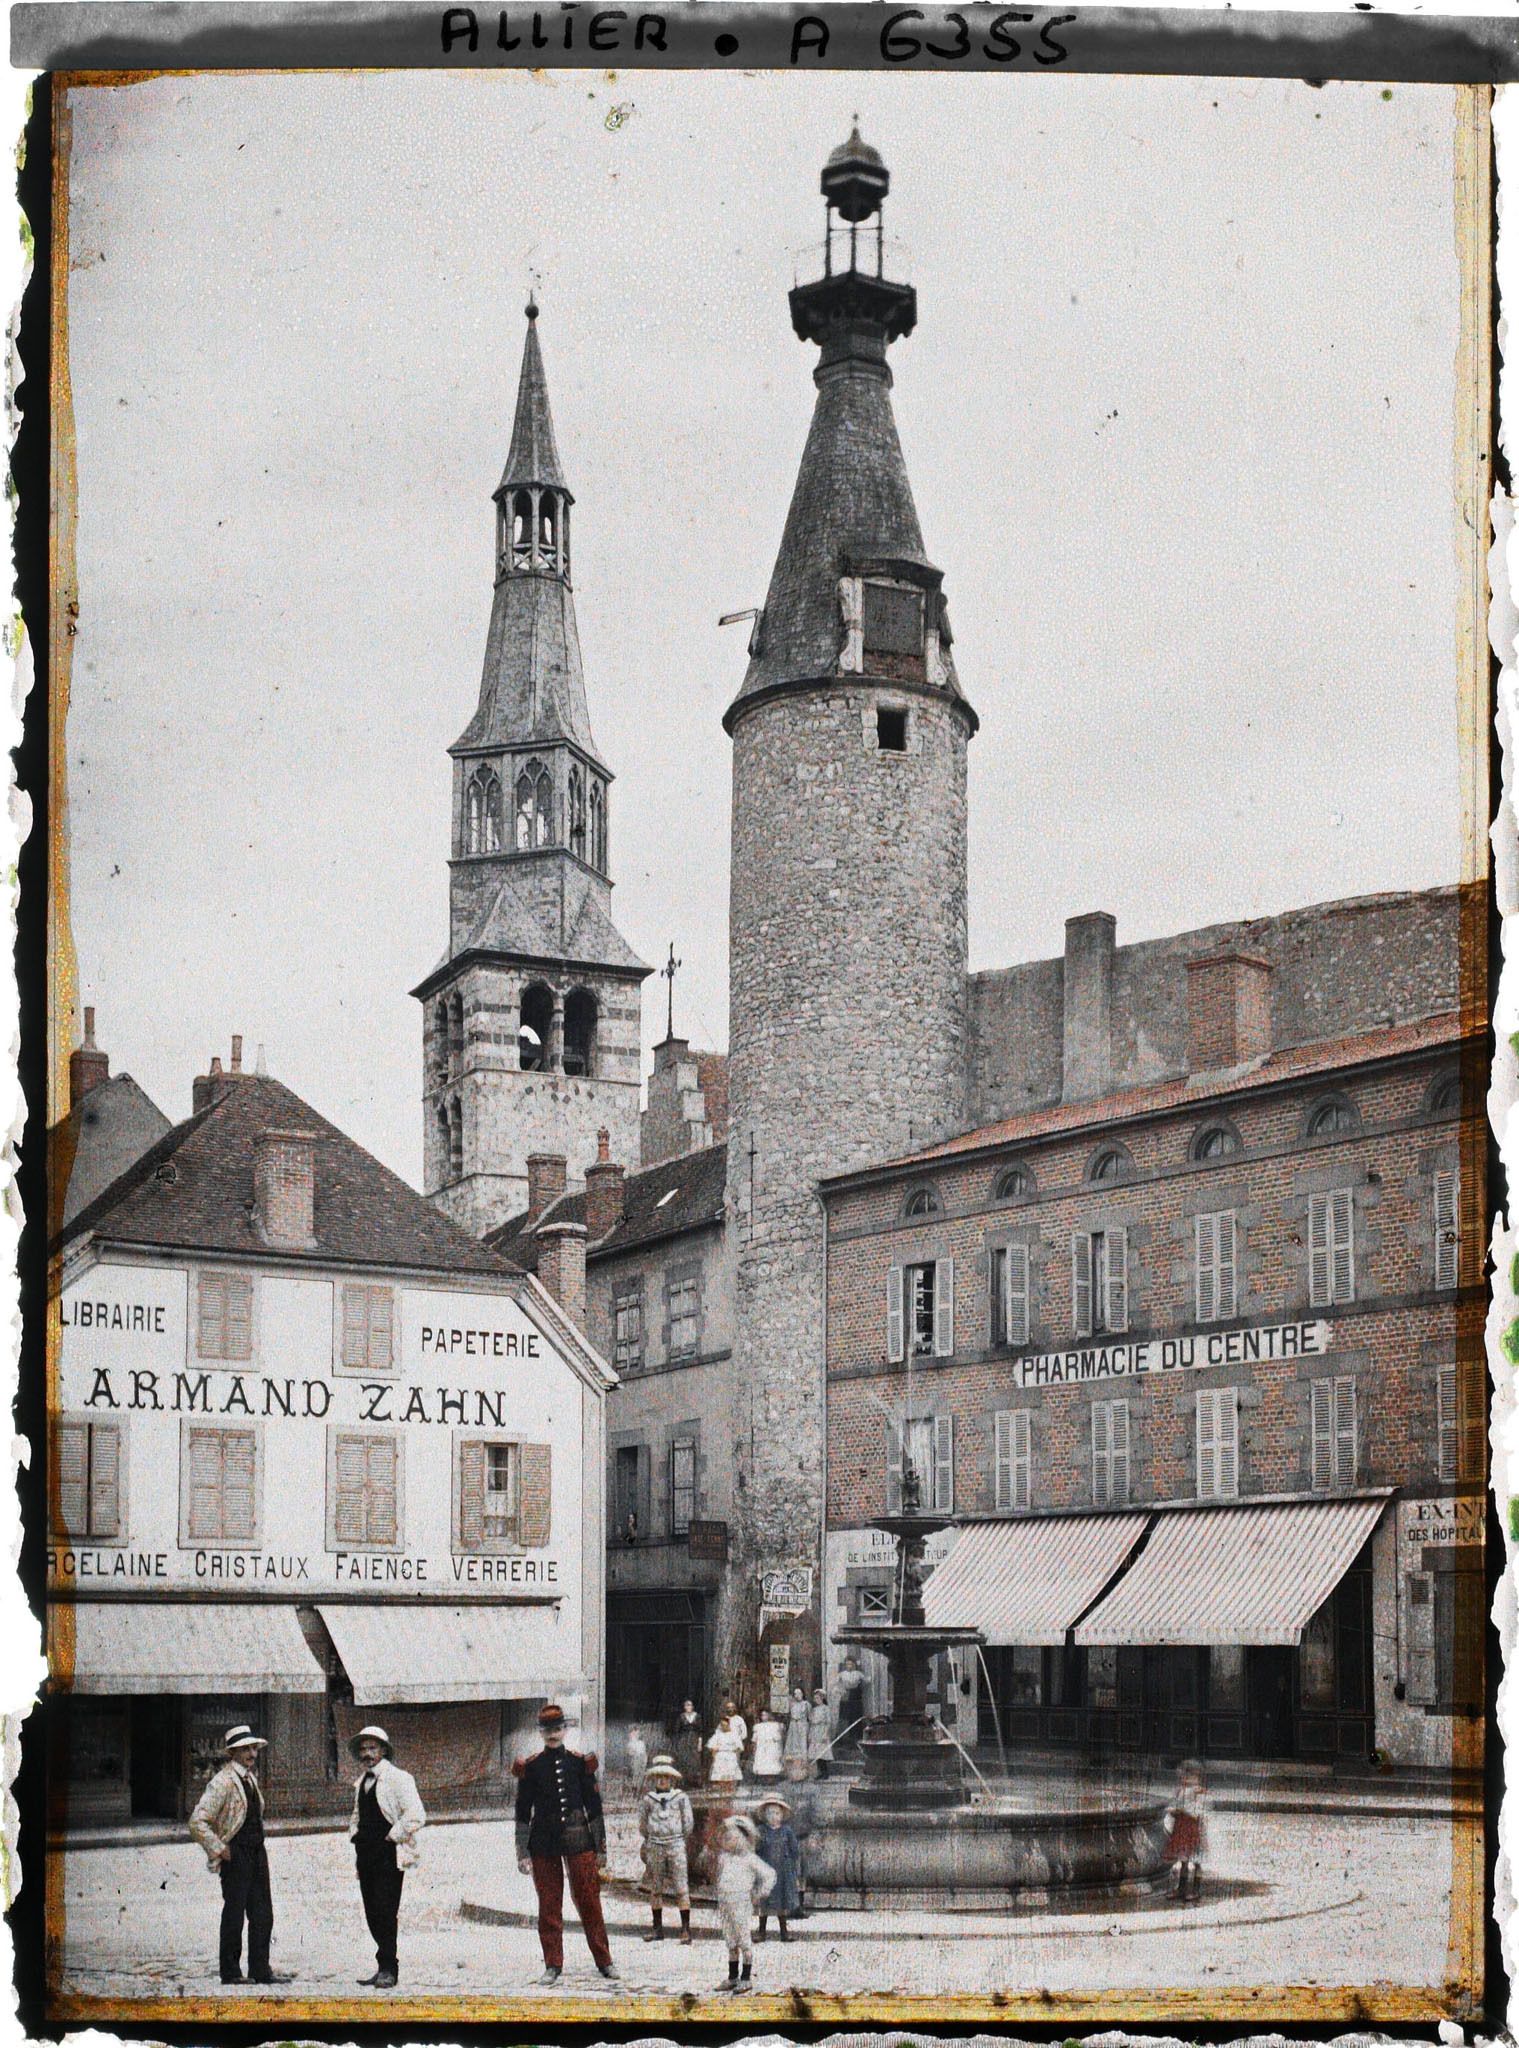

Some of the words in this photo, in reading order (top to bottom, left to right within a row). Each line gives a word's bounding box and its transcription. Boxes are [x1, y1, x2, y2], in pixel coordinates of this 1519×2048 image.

[60, 1299, 165, 1333] LIBRAIRIE
[421, 1326, 540, 1358] PAPETERIE
[1022, 1343, 1150, 1385] PHARMACIE
[1162, 1338, 1195, 1370] DU
[1208, 1322, 1320, 1365] CENTRE
[84, 1367, 335, 1418] ARMAND
[359, 1383, 507, 1427] ZAHN
[1408, 1529, 1429, 1542] DES
[195, 1550, 309, 1579] CRISTAUX
[335, 1553, 428, 1581] FAIENCE
[452, 1556, 558, 1582] VERRERIE
